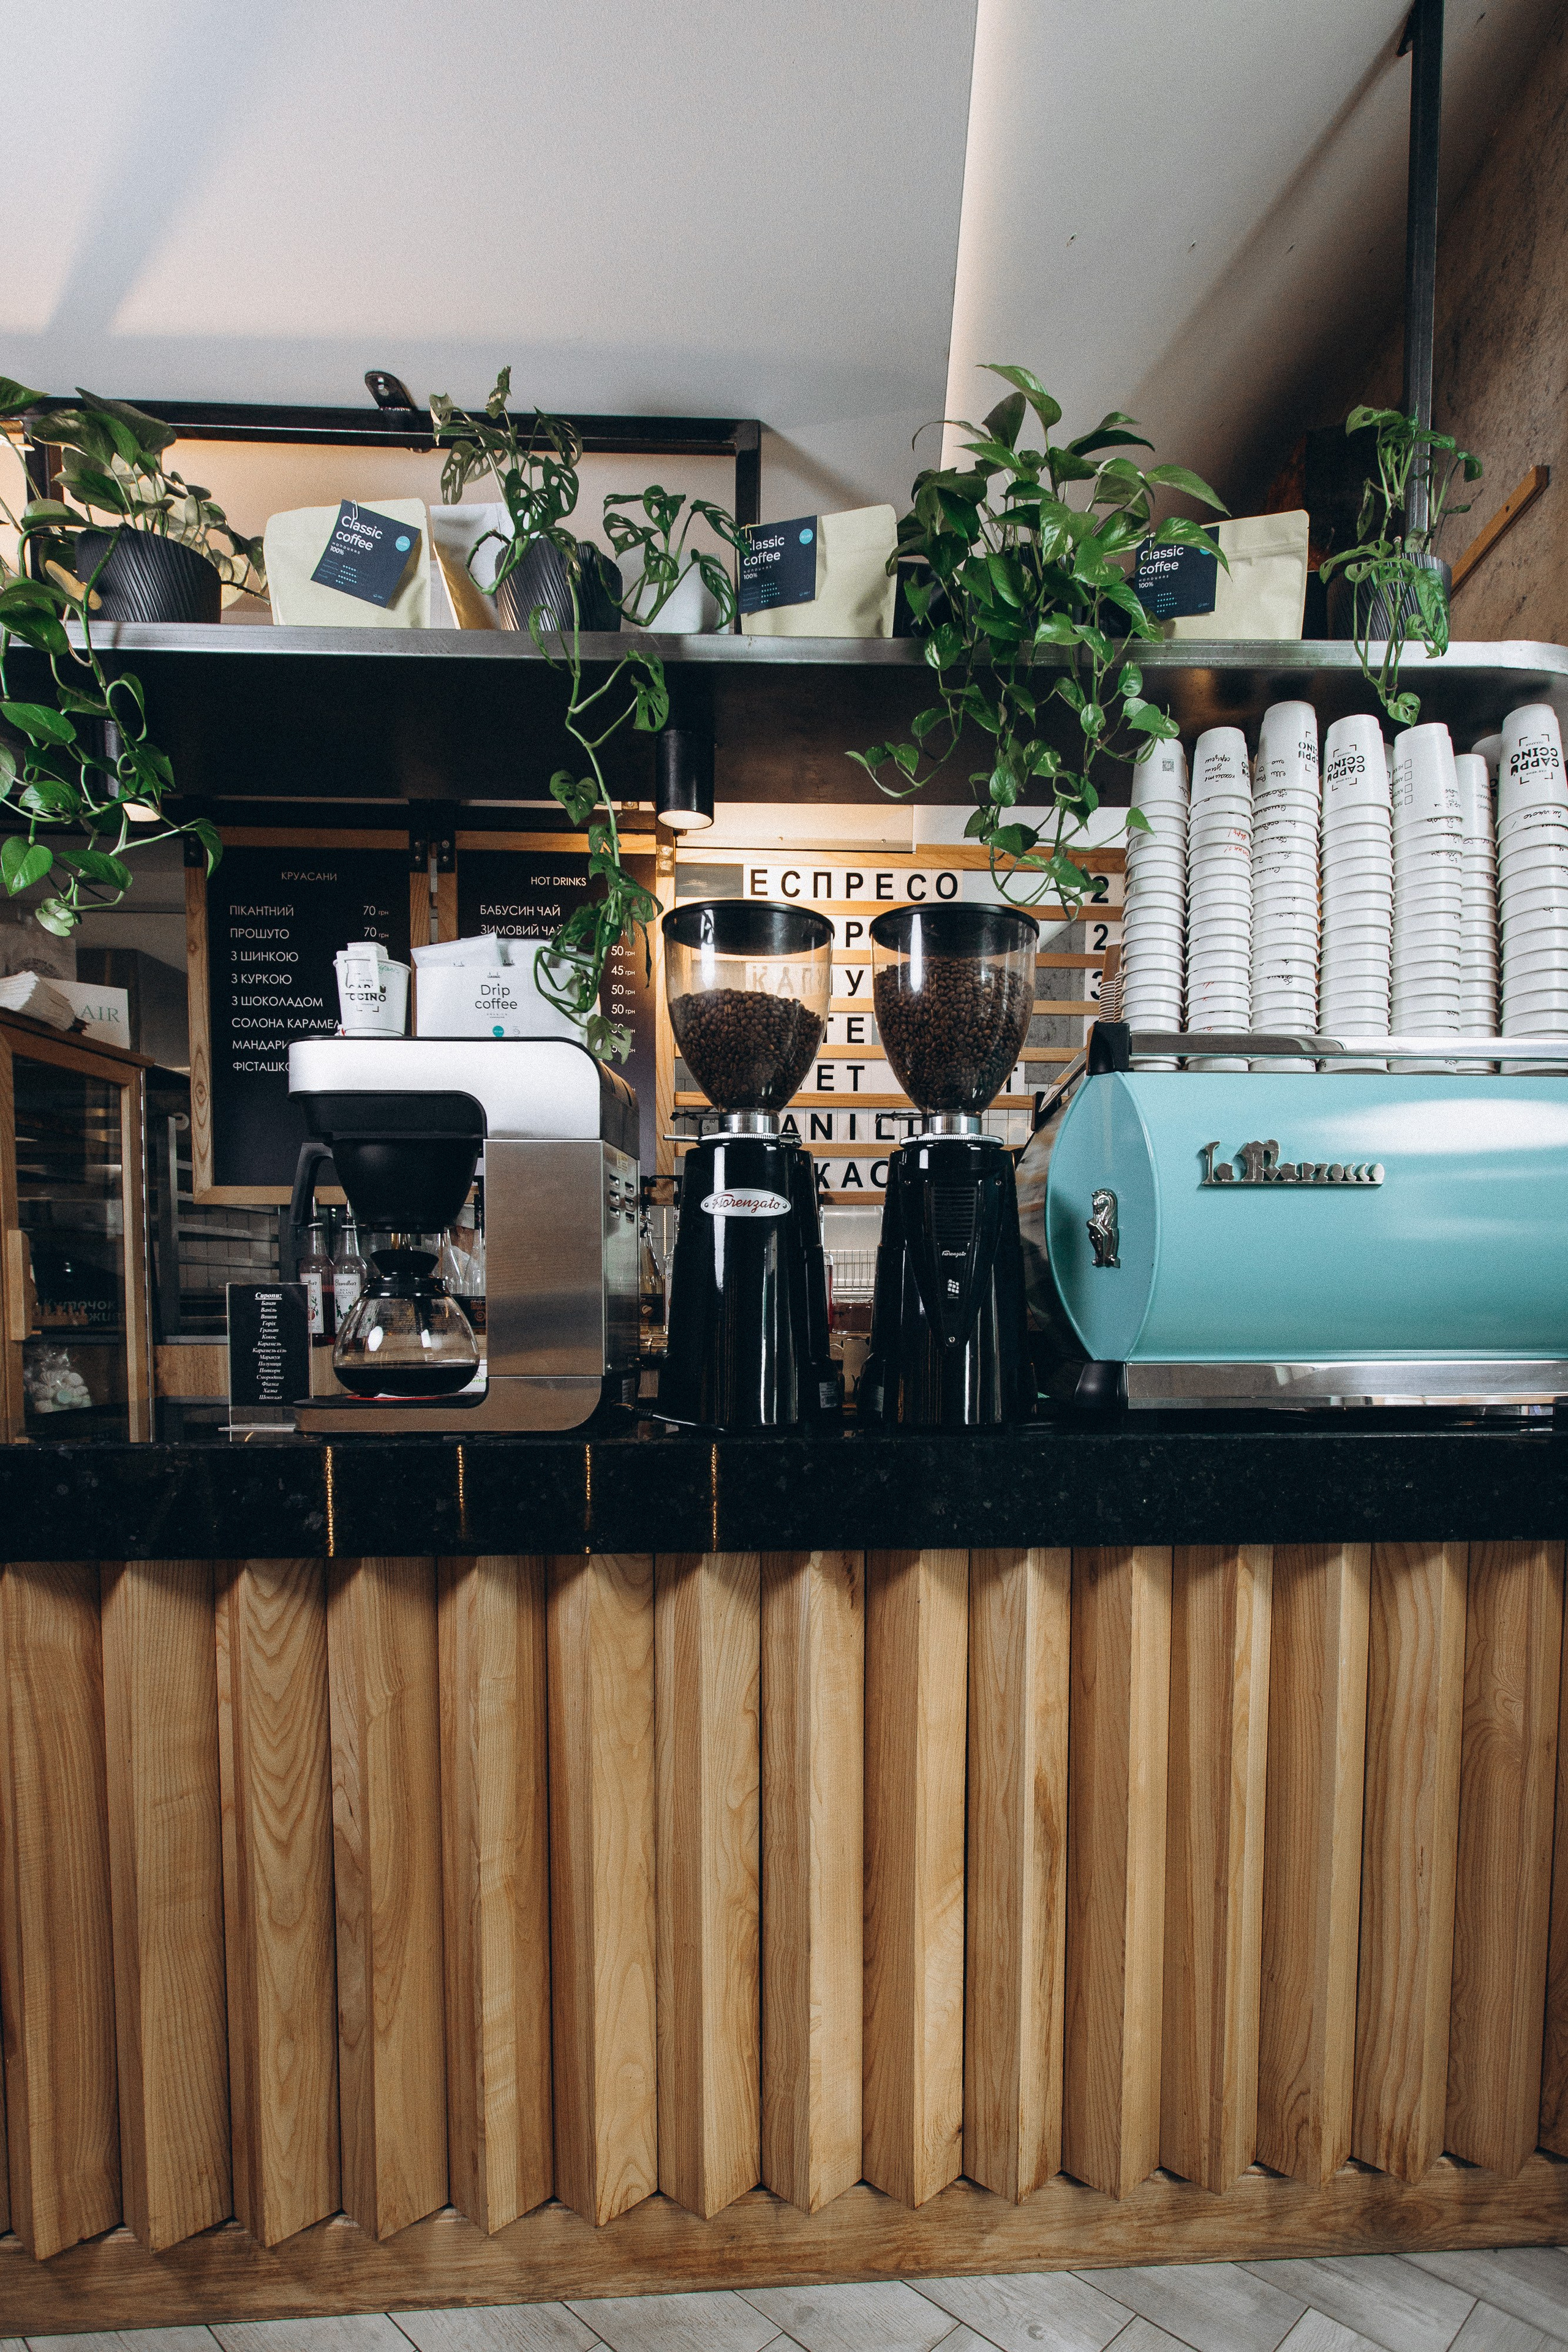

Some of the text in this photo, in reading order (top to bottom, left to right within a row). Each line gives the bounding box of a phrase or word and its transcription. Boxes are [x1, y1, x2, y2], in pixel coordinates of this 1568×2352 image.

[342, 516, 383, 539] Classic
[336, 532, 373, 551] coffee
[745, 535, 785, 551] lassic
[330, 545, 344, 555] 100%
[744, 552, 781, 566] coffee
[1139, 561, 1179, 575] coffee
[281, 872, 337, 881] КРУАСАНИ
[531, 876, 586, 886] HOT DRINKS
[750, 869, 958, 901] ЕСПРЕСО
[230, 904, 294, 916] ПІКАНТНИЙ
[363, 906, 375, 916] 70
[480, 905, 560, 916] БАБУСИН ЧАЙ
[230, 929, 290, 939] ПРОШУТО
[364, 927, 377, 937] 70
[480, 924, 539, 935] ЗИМОВИЙ
[1093, 924, 1109, 951] 2
[611, 946, 624, 956] 50
[241, 952, 298, 962] ШИНКОЮ
[611, 965, 624, 975] 45
[241, 974, 292, 985] КУРКОЮ
[481, 983, 510, 998] Drip
[611, 985, 624, 995] 50
[241, 996, 323, 1008] ШОКОЛАДОМ
[475, 998, 518, 1009] coffee
[81, 1005, 121, 1022] AIR
[611, 1005, 624, 1014] 50
[232, 1018, 339, 1029] СОЛОНА КАРАМЕЛ
[233, 1040, 287, 1050] МАНДАРИ
[1202, 1139, 1385, 1183] La Marzocco
[712, 1194, 781, 1213] Fiorenzato
